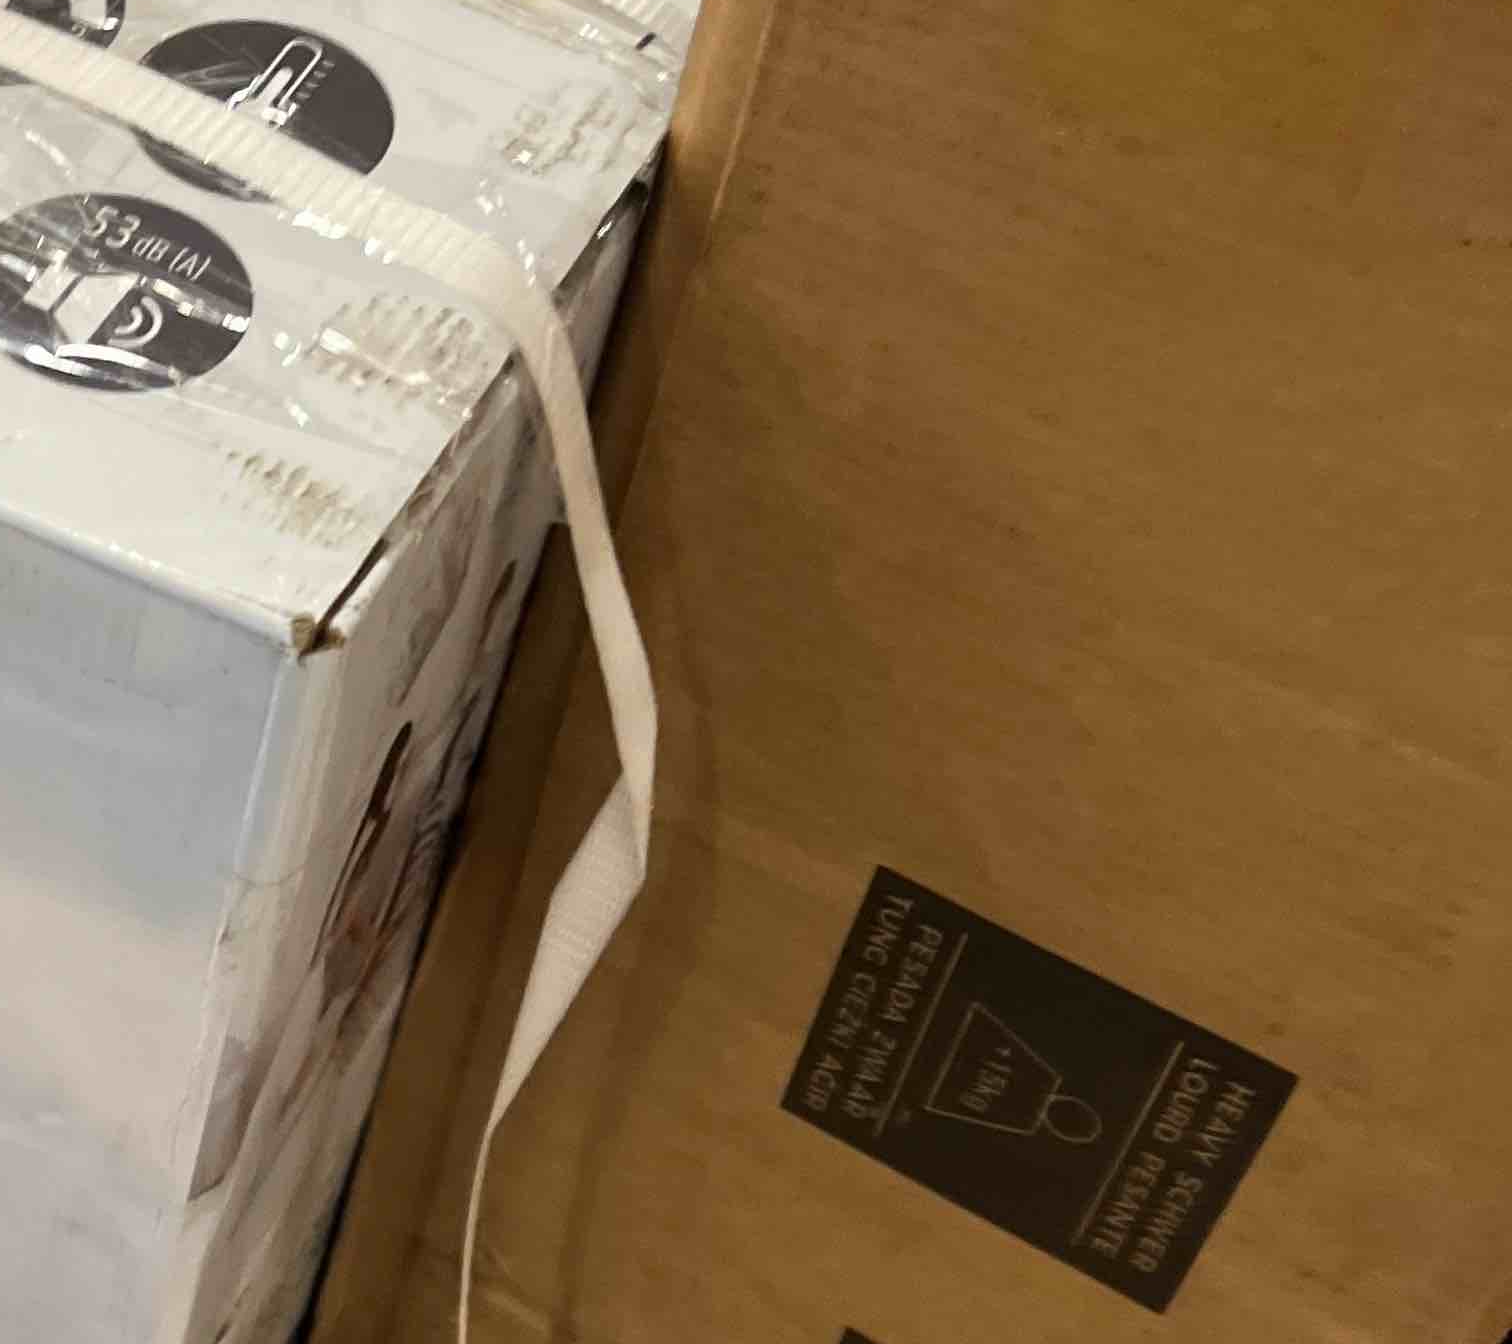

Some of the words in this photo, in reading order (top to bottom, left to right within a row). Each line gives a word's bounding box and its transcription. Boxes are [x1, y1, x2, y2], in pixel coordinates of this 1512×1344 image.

[86, 205, 142, 250] 53
[131, 235, 171, 263] dB
[167, 246, 213, 283] (A)
[1149, 1051, 1220, 1149] LOURD
[1186, 1076, 1258, 1171] HEAVY
